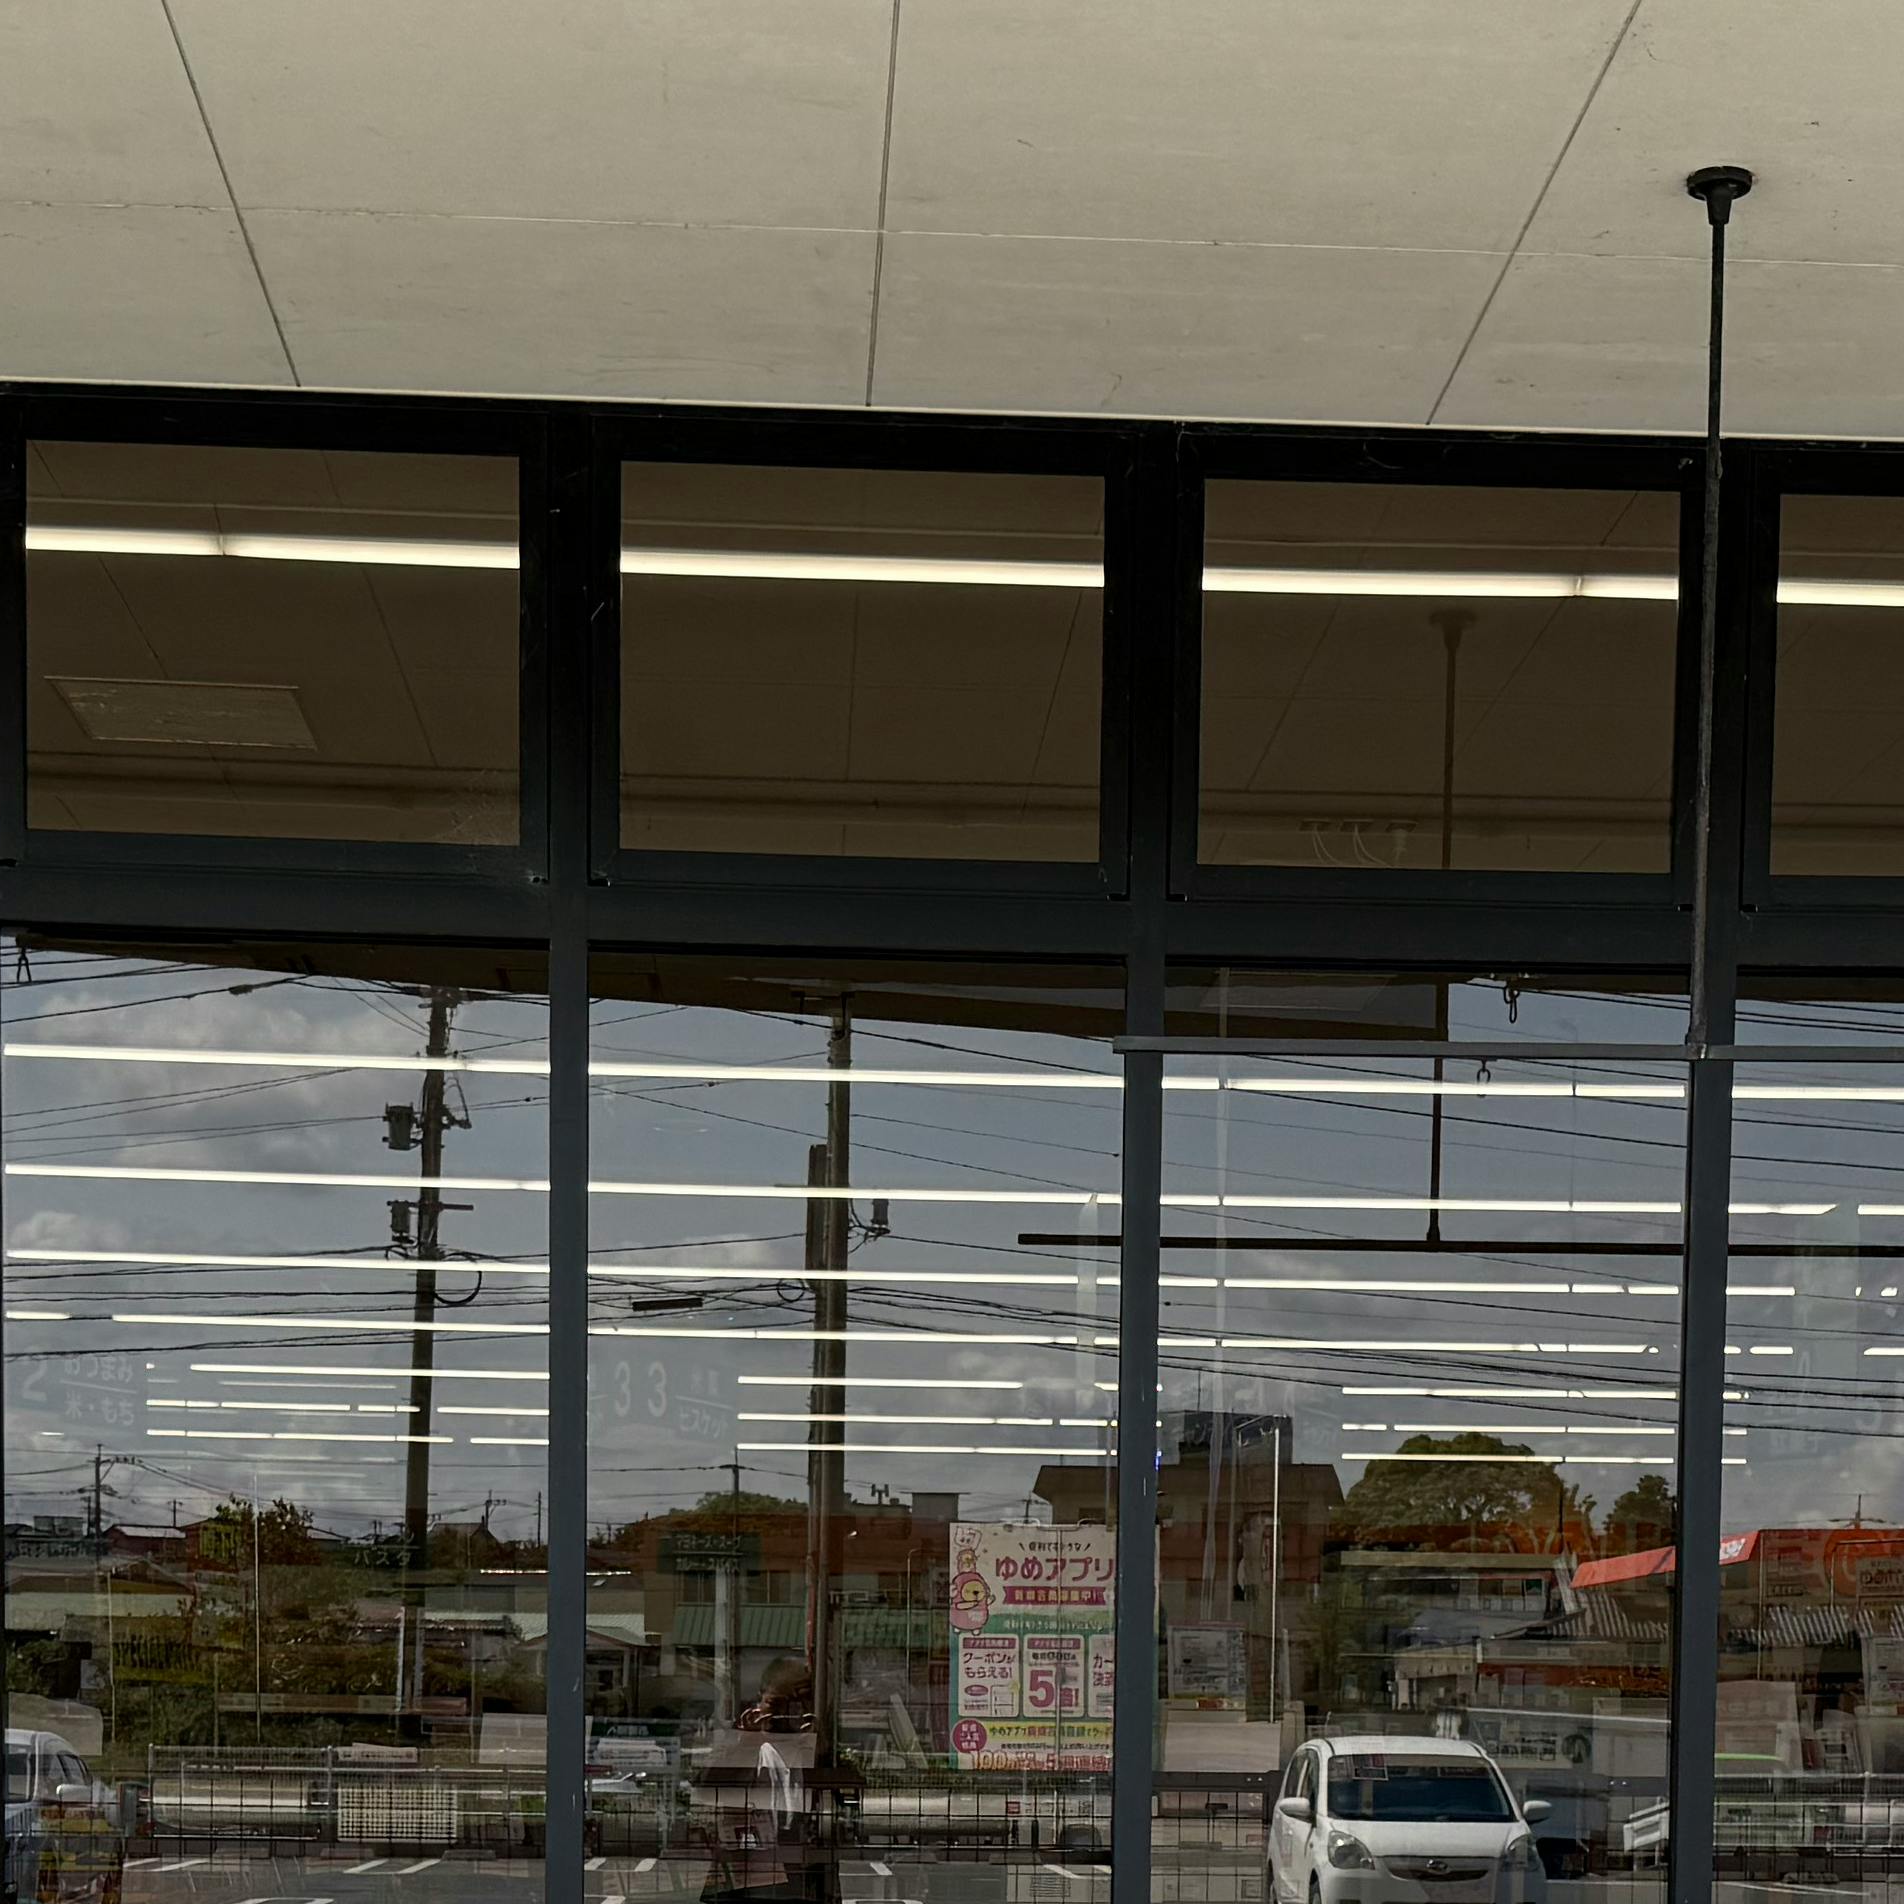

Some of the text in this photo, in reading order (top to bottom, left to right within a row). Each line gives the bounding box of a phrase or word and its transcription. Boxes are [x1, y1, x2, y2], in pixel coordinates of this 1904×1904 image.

[646, 1361, 667, 1417] 3
[995, 1556, 1114, 1582] ゆめアプリ
